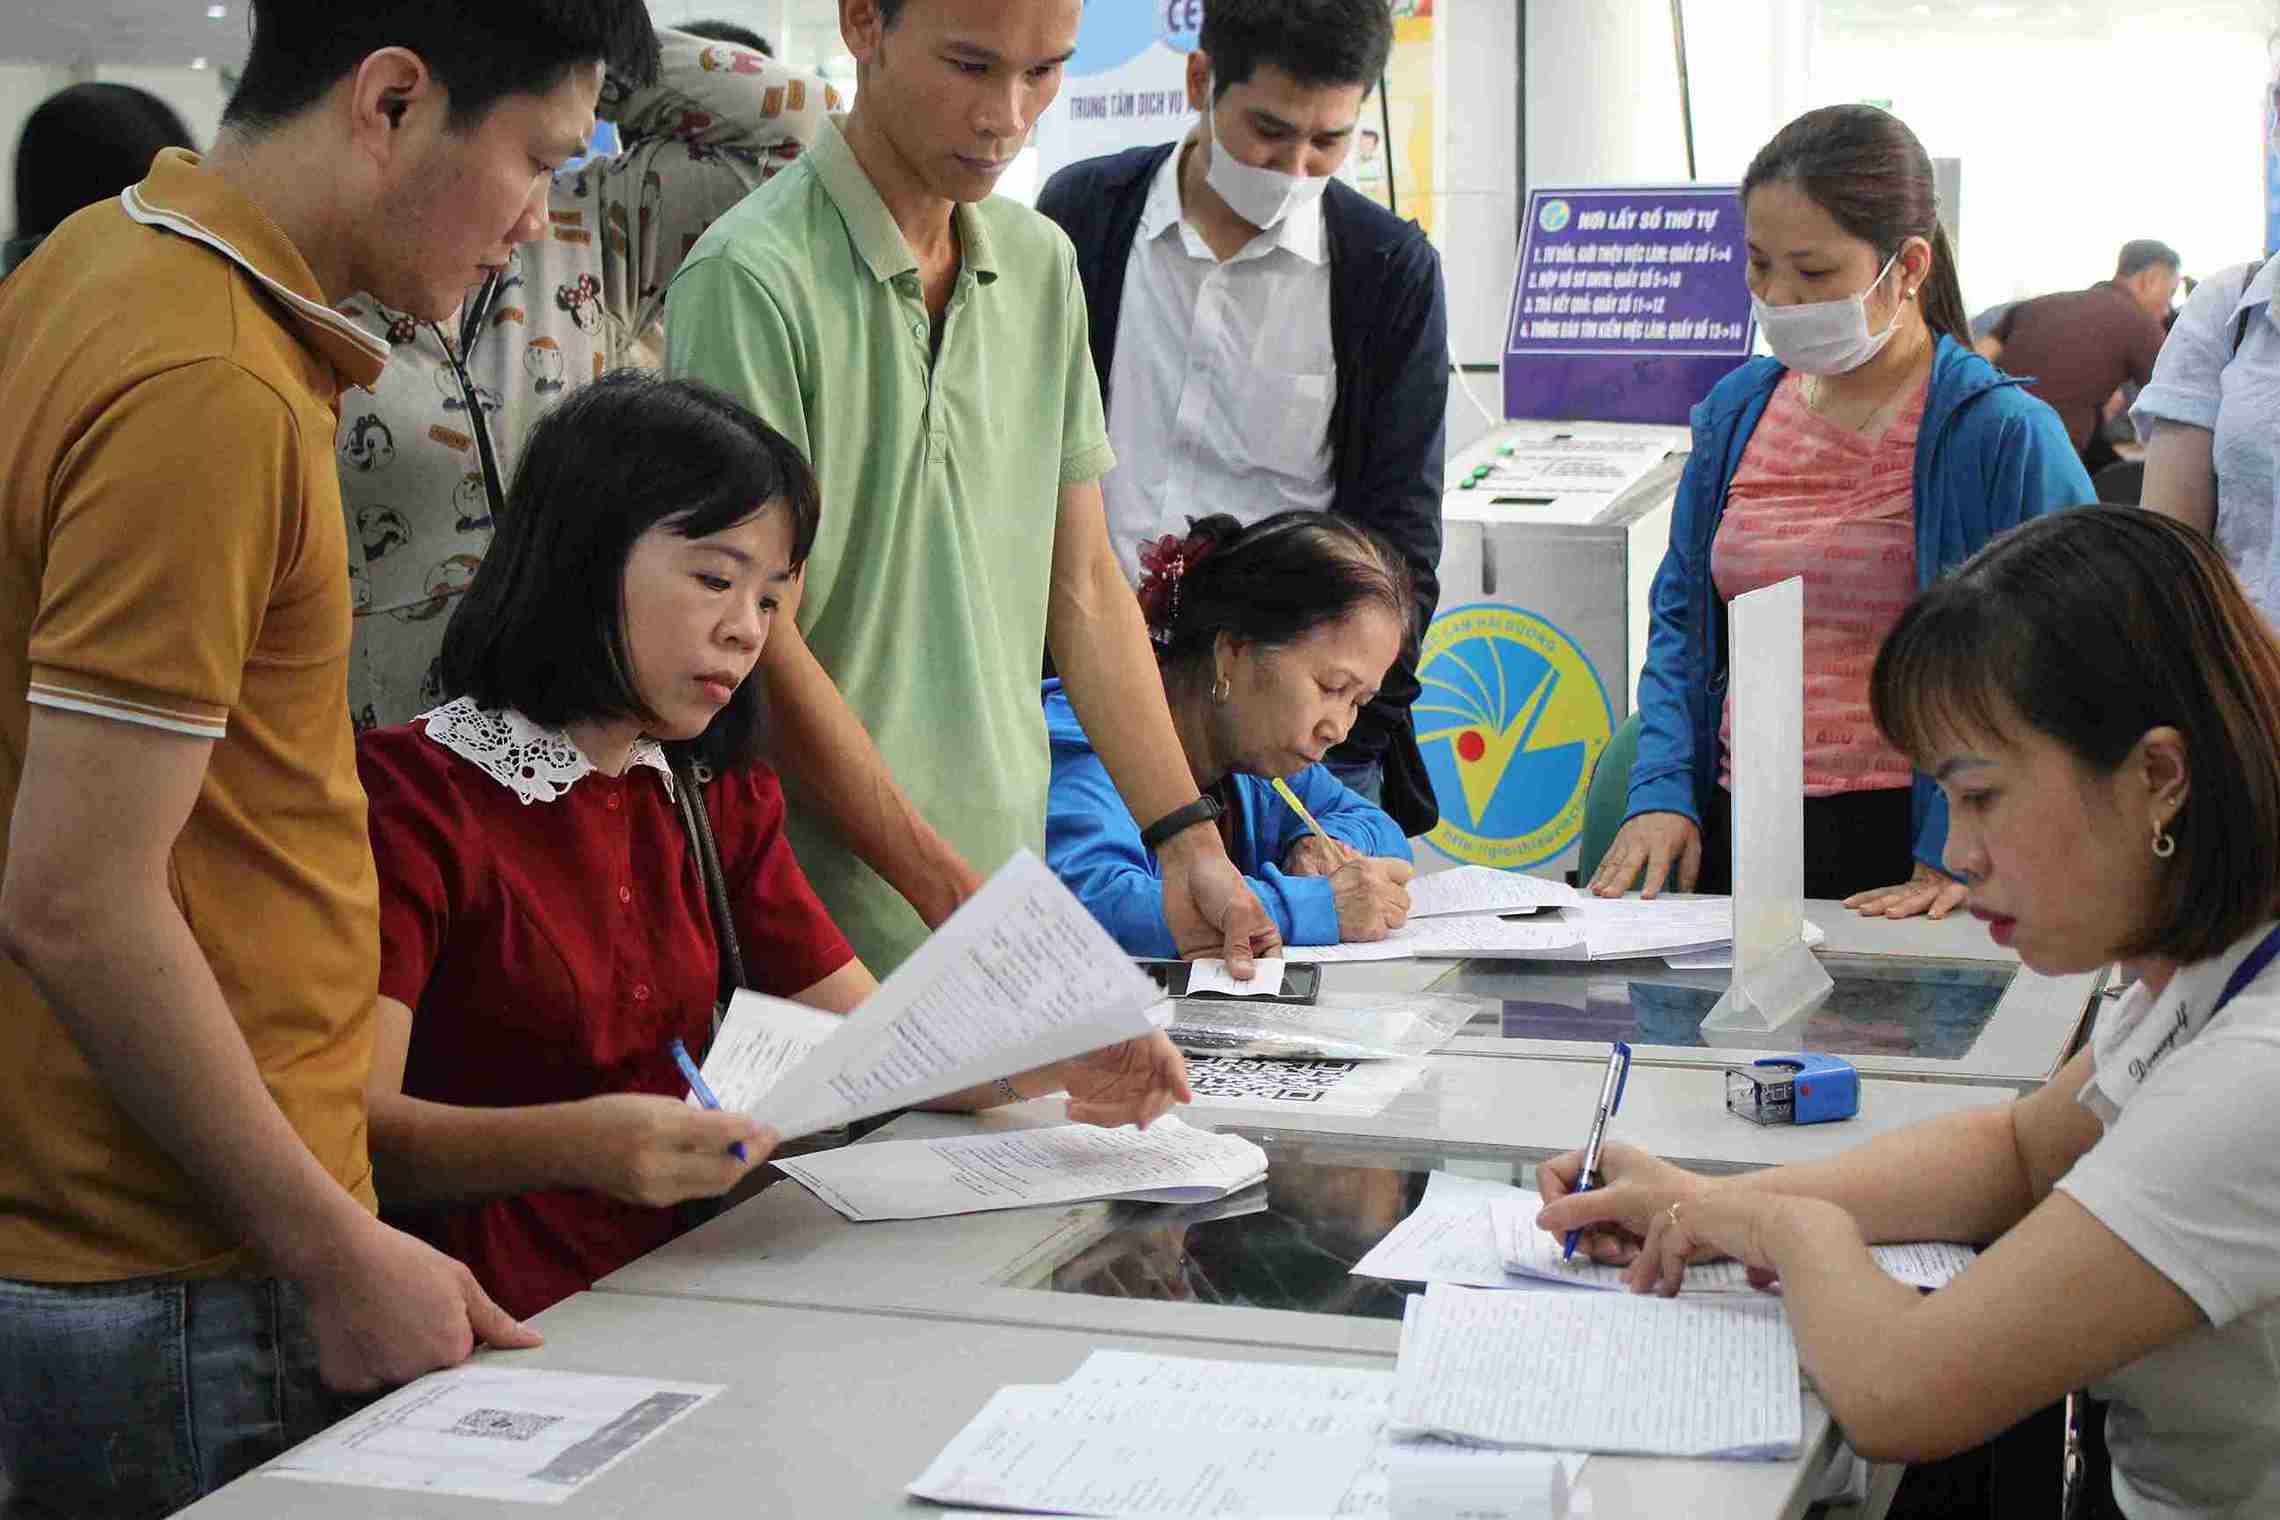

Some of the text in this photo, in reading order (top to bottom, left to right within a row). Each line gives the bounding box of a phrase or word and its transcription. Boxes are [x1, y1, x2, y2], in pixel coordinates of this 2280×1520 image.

[1070, 95, 1106, 120] TRUNG
[1607, 205, 1638, 230] LẤY
[1639, 206, 1664, 230] SỐ
